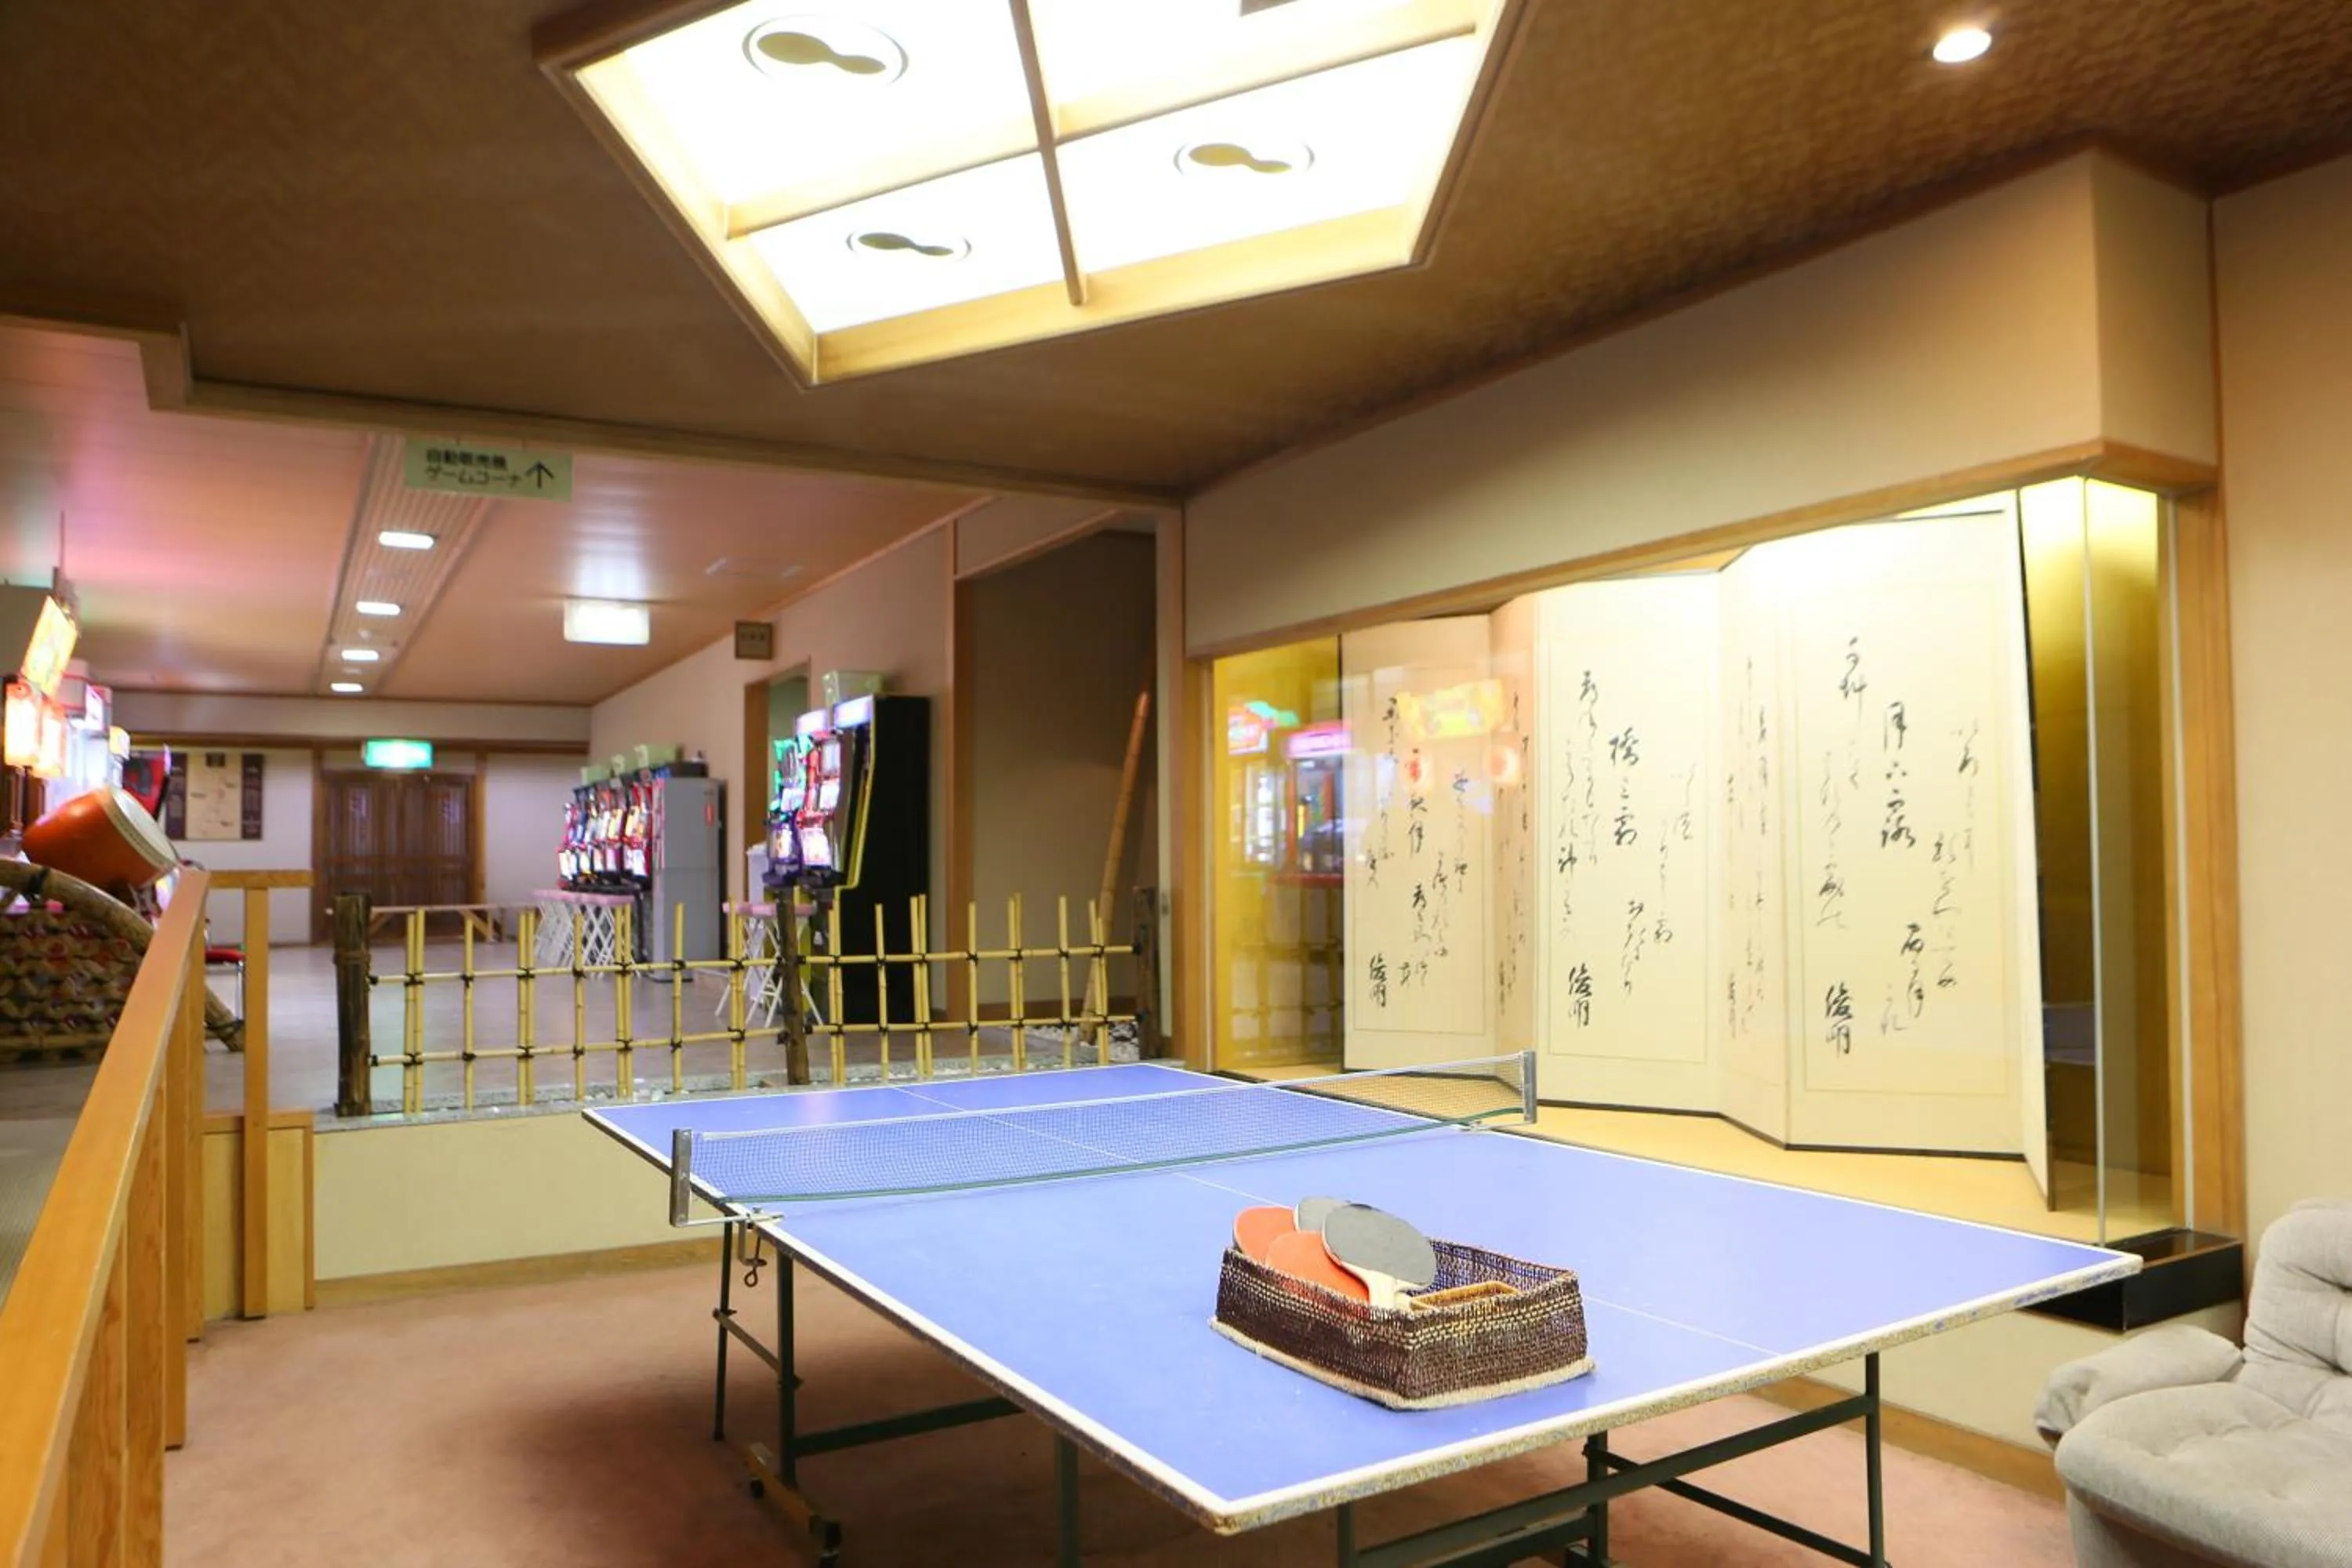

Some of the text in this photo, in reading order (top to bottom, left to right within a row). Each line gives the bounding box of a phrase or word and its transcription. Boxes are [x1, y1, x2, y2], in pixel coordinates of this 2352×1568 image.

[426, 448, 507, 471] 自動販売機
